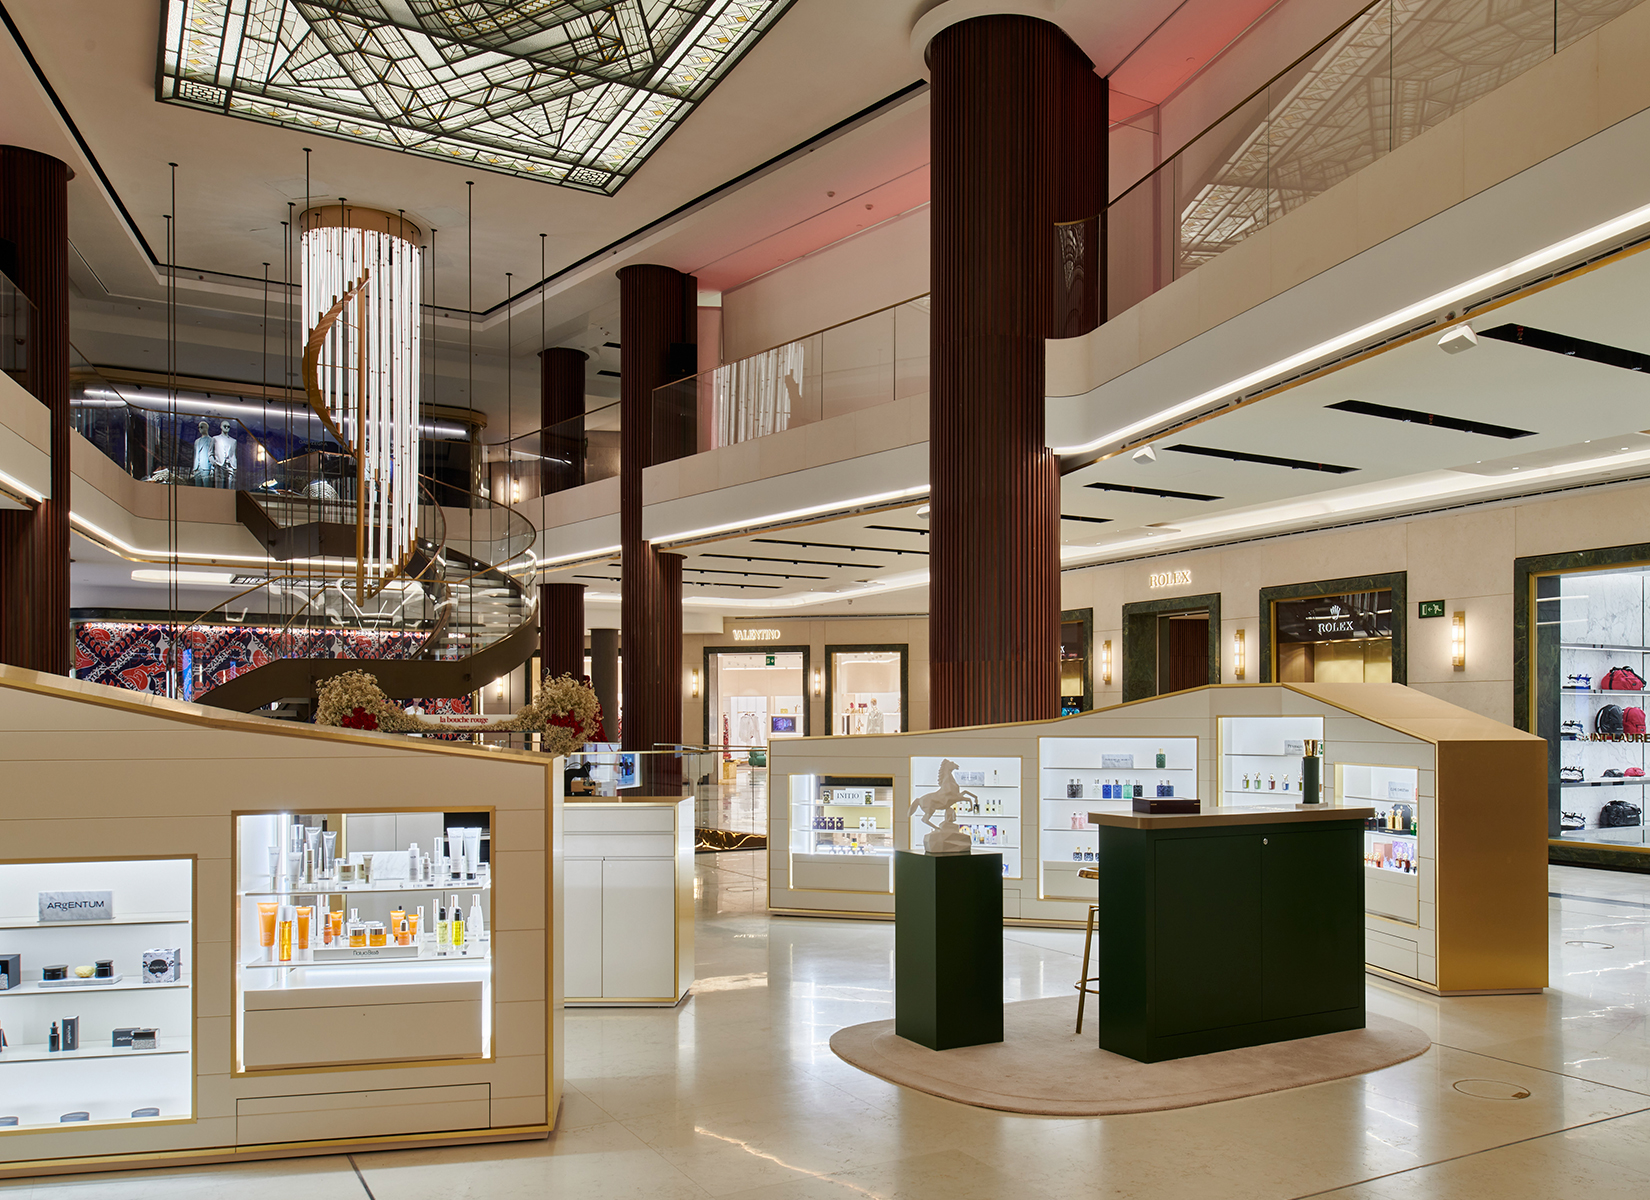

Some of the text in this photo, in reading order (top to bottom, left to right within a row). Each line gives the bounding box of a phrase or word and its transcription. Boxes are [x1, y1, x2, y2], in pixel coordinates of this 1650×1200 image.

[1149, 570, 1192, 588] ROLEX
[1318, 621, 1354, 632] ROLEX
[733, 629, 781, 640] VALENTINO
